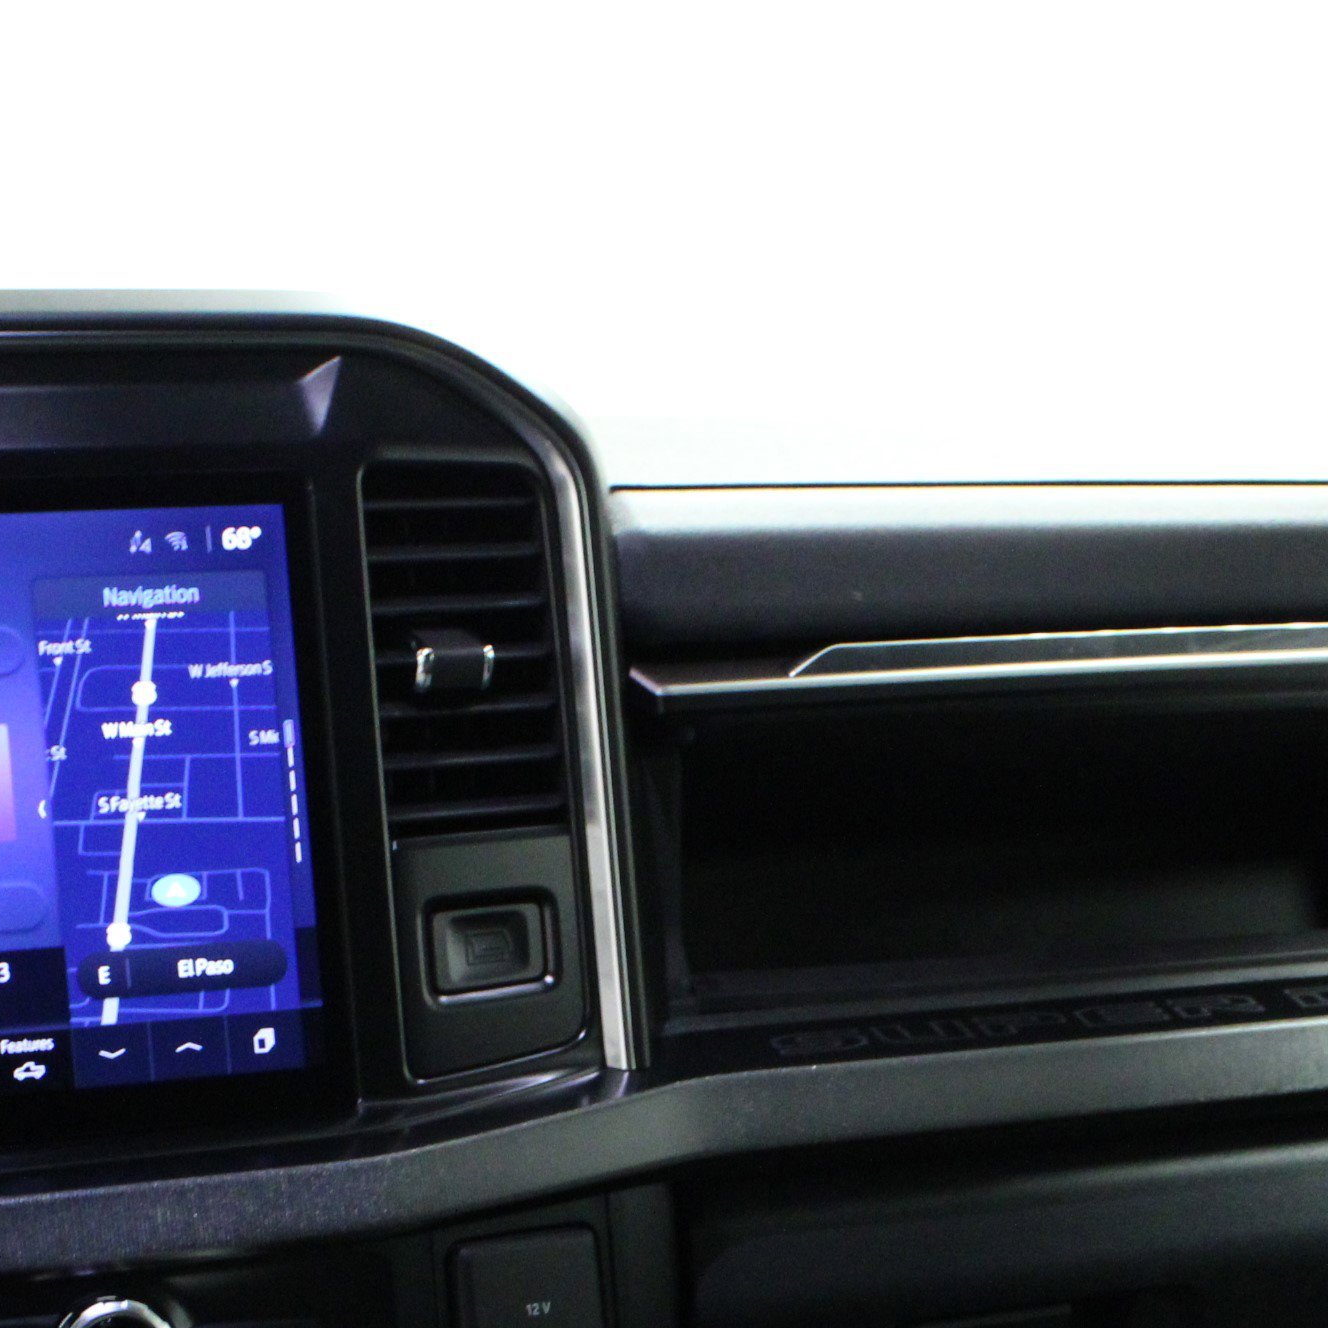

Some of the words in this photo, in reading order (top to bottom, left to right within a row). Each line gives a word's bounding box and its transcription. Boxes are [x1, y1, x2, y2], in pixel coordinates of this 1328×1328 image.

[221, 526, 262, 550] 68°
[103, 584, 200, 608] Navigation
[38, 640, 74, 656] Front
[74, 638, 93, 655] St
[187, 663, 203, 679] W
[101, 721, 119, 740] W
[154, 718, 173, 737] St
[97, 795, 110, 814] S
[164, 791, 182, 810] St
[98, 965, 111, 985] E
[177, 958, 195, 978] El
[194, 957, 234, 977] Paso
